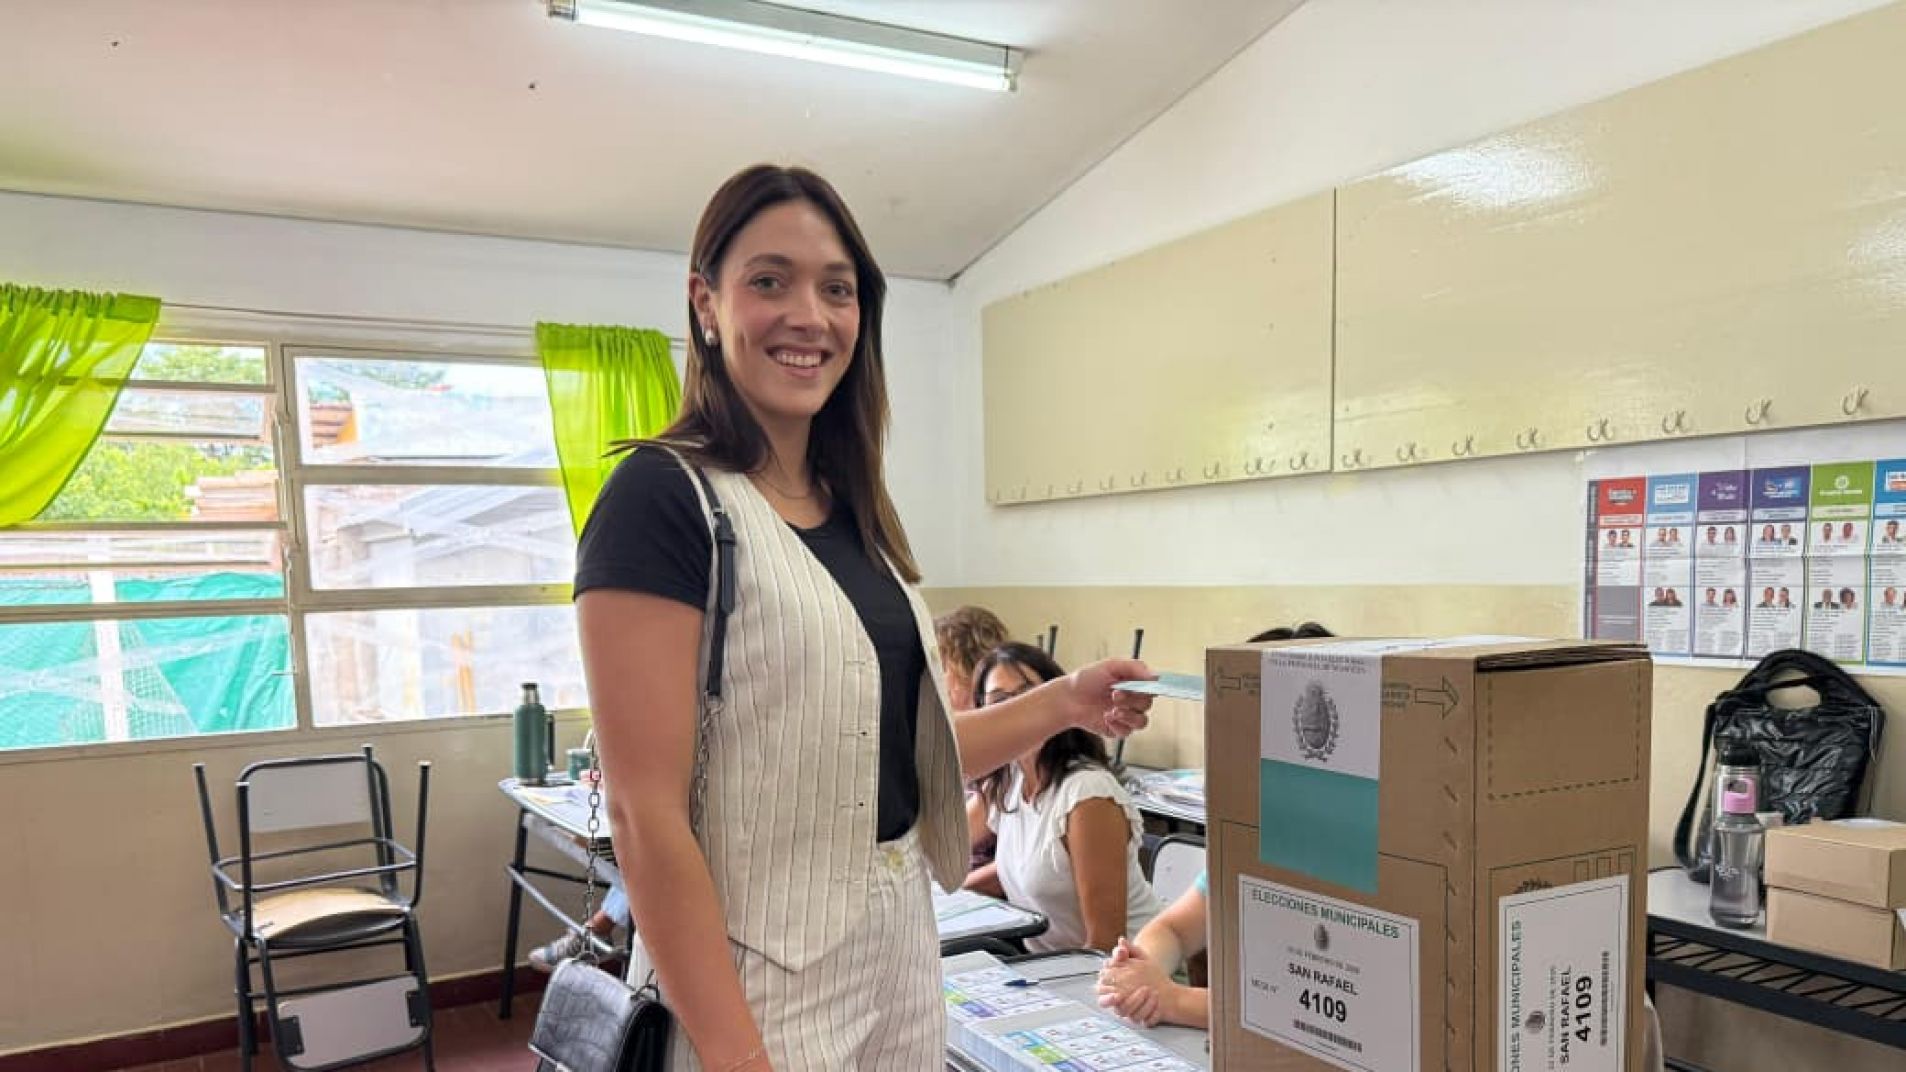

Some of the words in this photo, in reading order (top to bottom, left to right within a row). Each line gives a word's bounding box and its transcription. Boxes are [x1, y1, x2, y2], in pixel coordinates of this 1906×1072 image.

[1252, 888, 1318, 917] ELECCIONES
[1320, 905, 1400, 939] MUNICIPALES
[1288, 961, 1311, 979] SAN
[1313, 970, 1359, 996] RAFAEL
[1511, 919, 1522, 1029] MUNICIPALES
[1560, 965, 1572, 1029] RAFAEL
[1299, 988, 1347, 1023] 4109
[1575, 975, 1593, 1042] 4109
[1560, 1030, 1570, 1064] SAN
